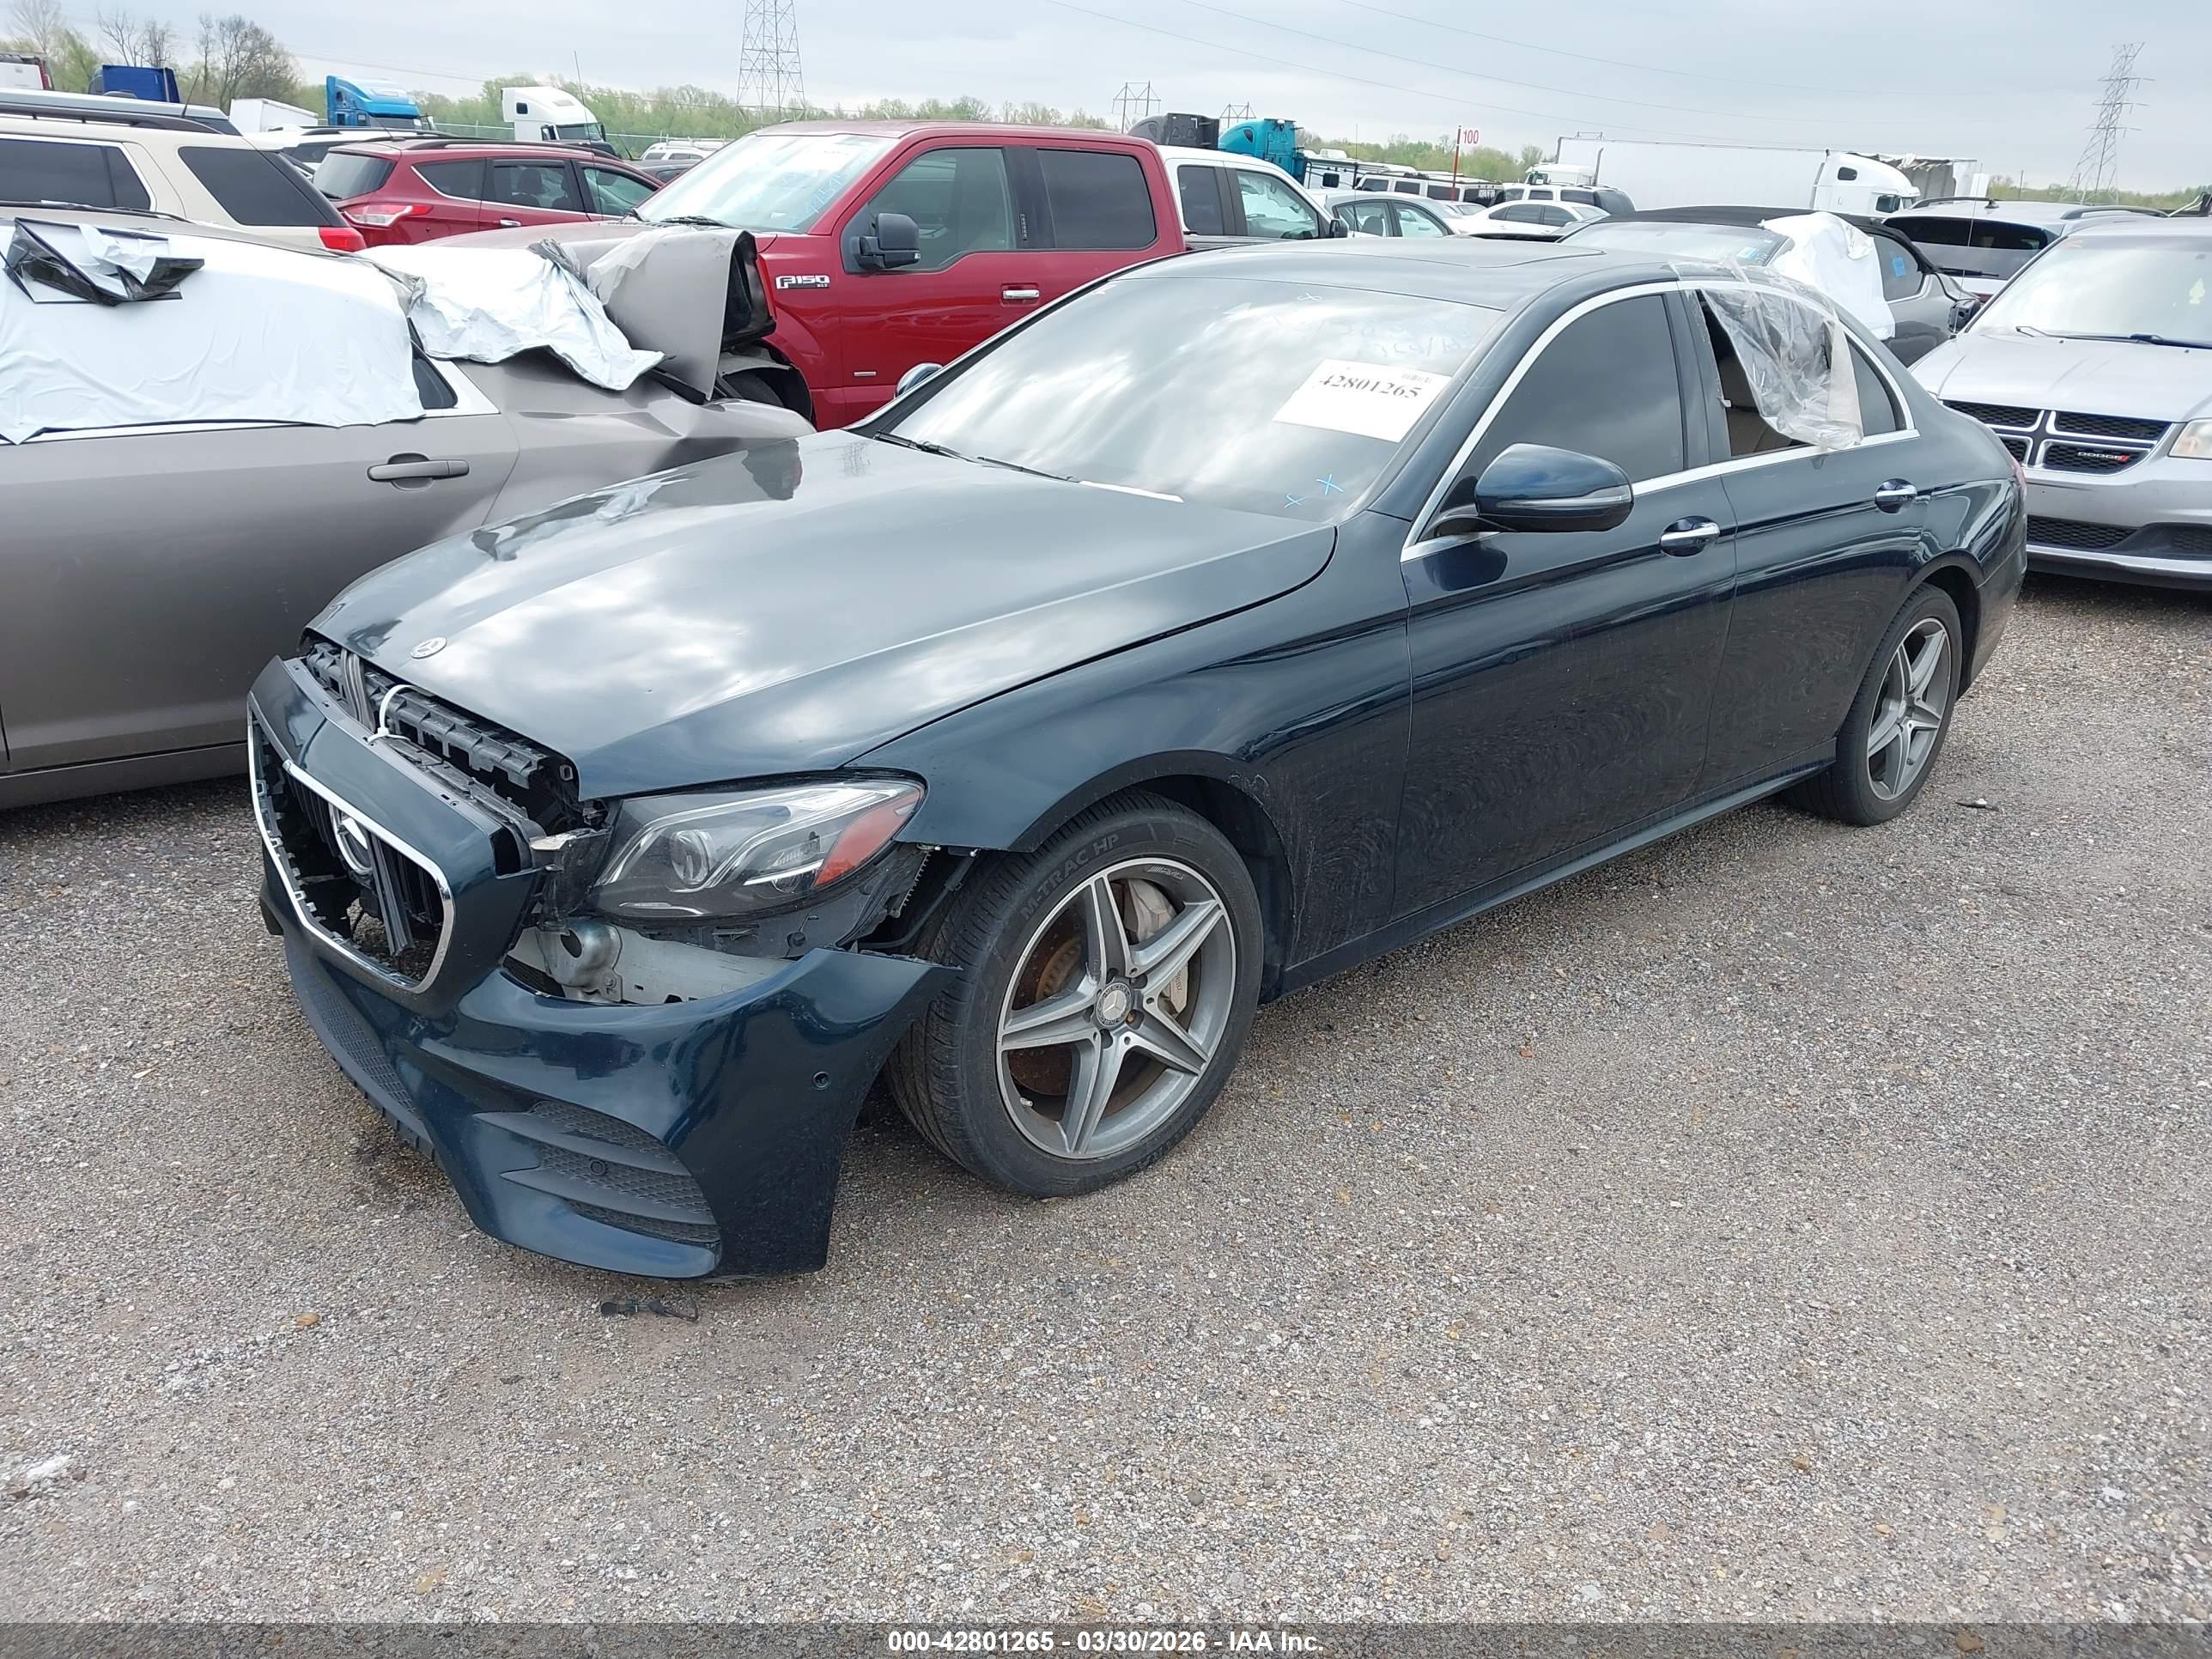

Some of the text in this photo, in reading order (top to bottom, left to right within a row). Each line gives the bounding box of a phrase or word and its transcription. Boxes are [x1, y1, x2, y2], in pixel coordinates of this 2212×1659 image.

[1463, 130, 1480, 144] 100
[1319, 374, 1423, 399] 42801265
[2077, 452, 2123, 461] DODGE
[1019, 833, 1120, 921] M-TRAC HP
